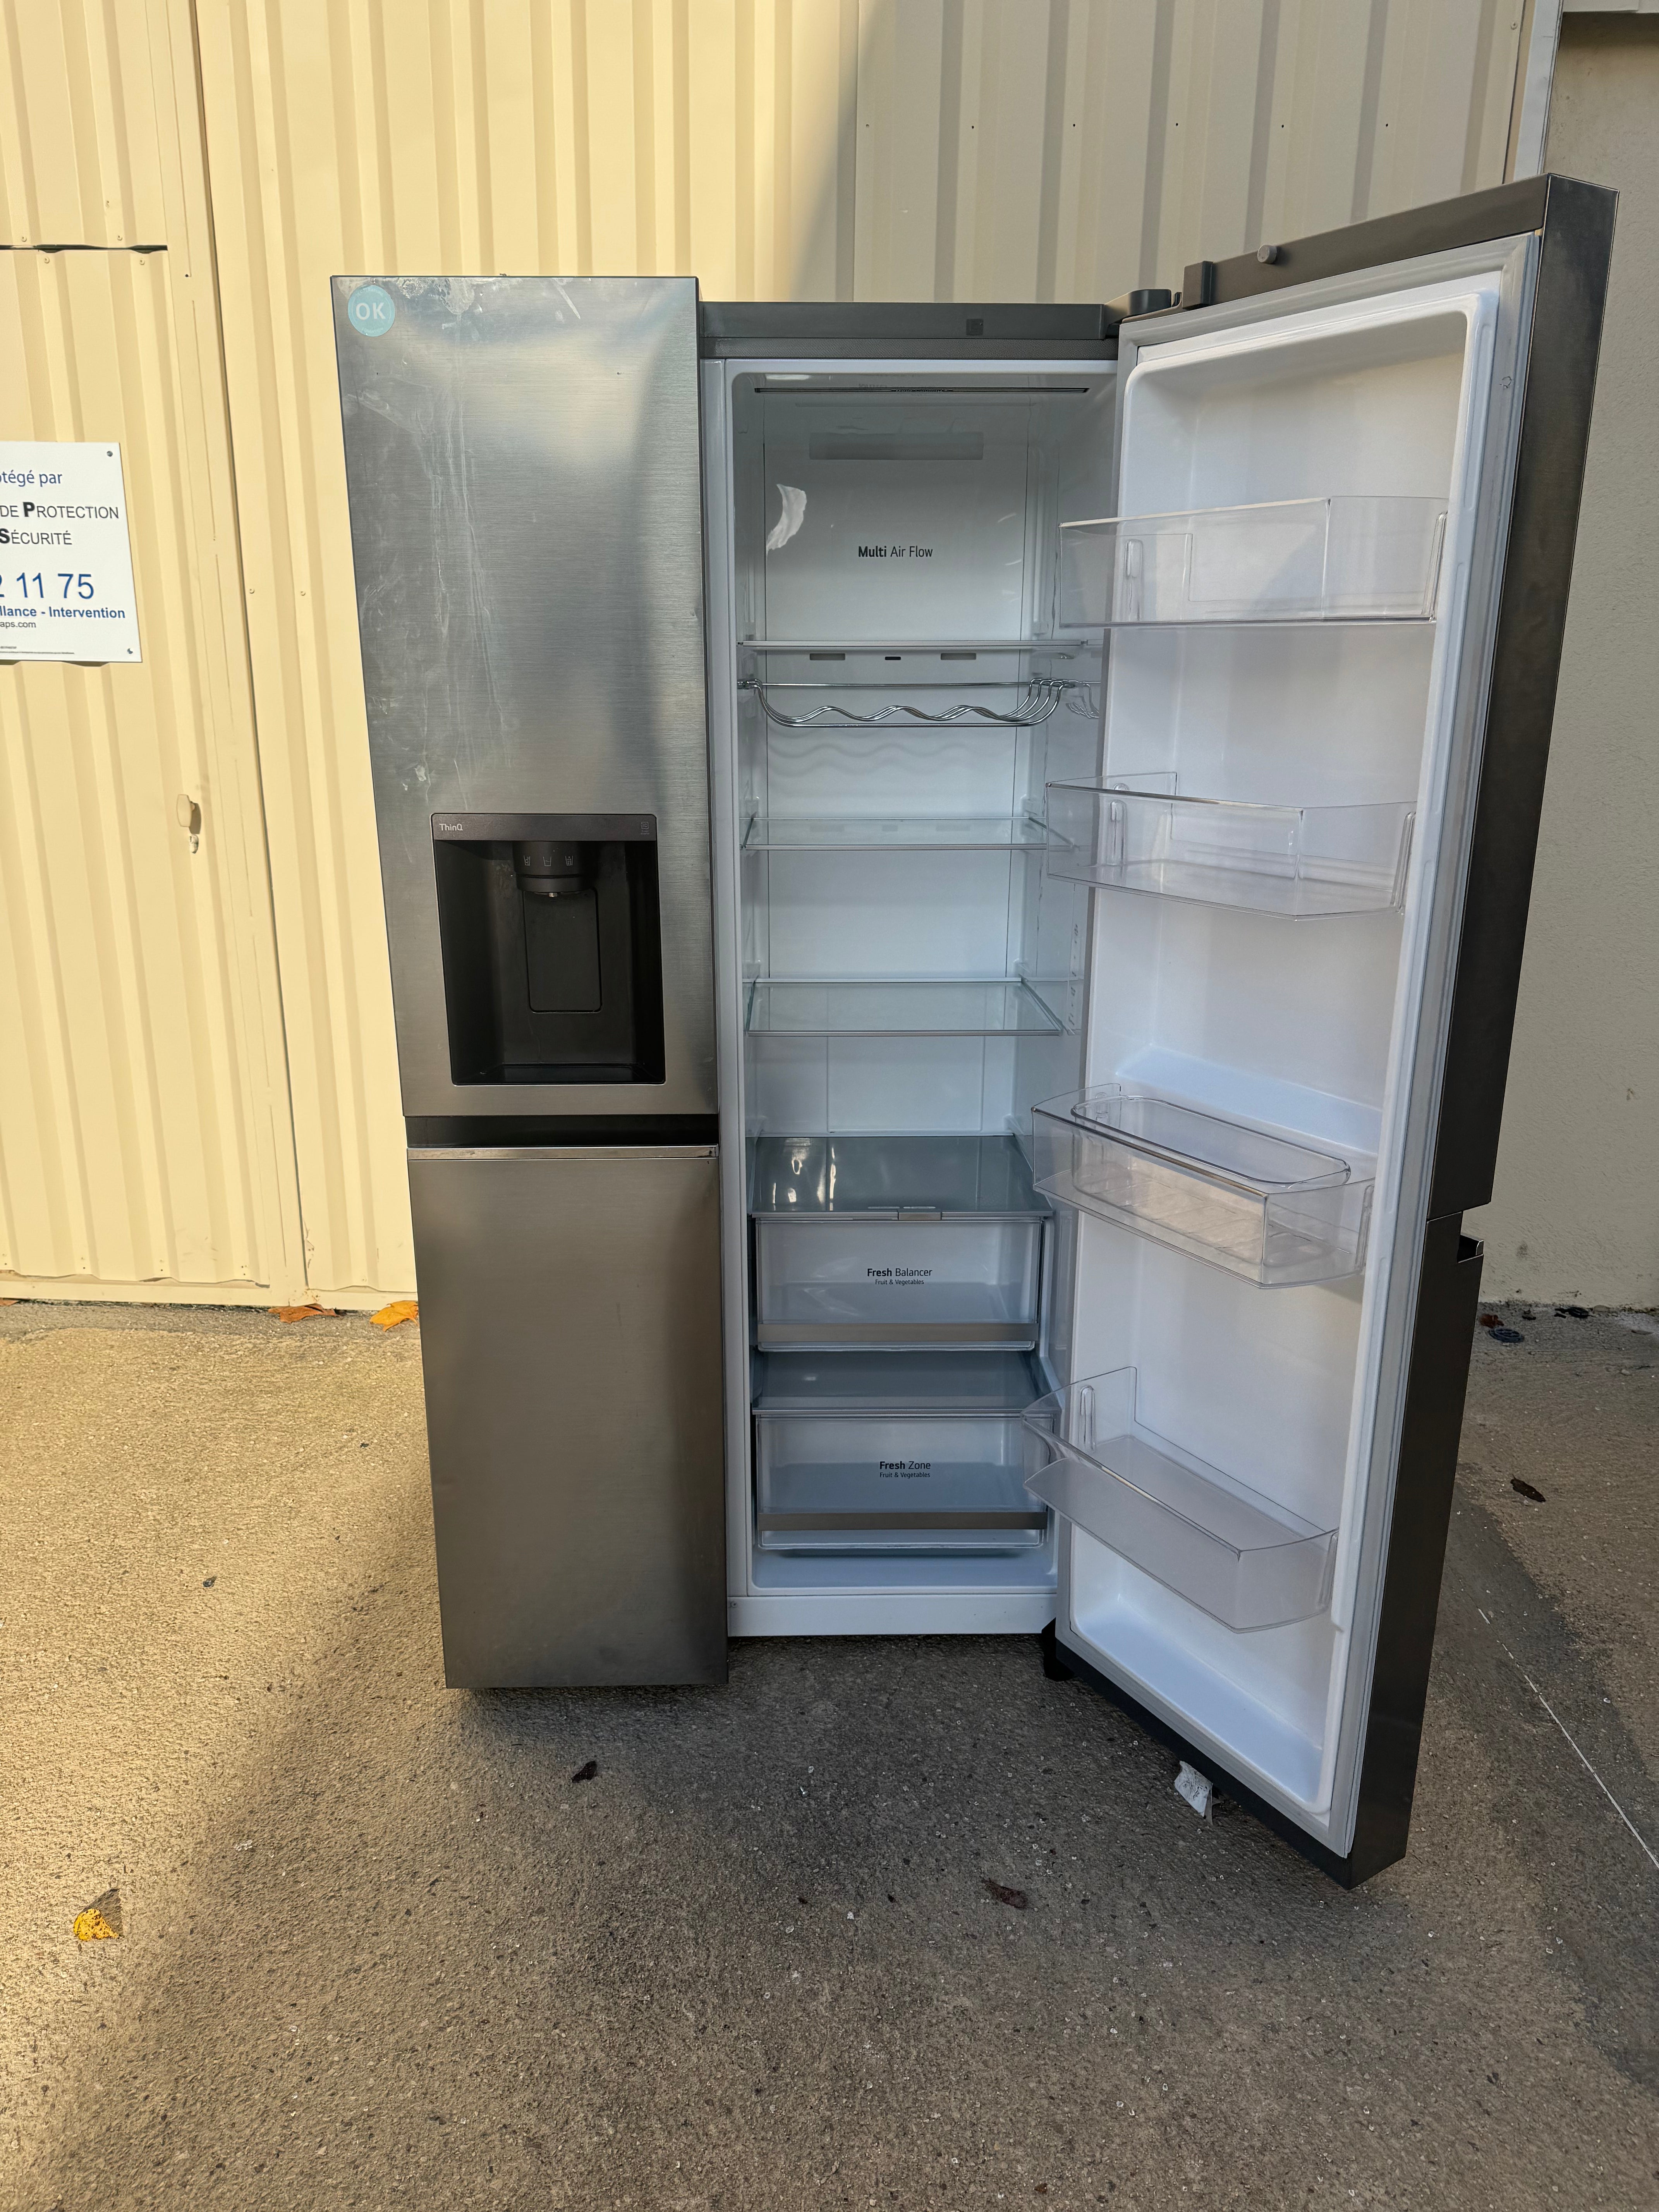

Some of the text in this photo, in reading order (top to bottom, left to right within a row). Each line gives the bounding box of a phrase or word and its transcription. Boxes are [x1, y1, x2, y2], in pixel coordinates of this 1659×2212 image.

[356, 302, 386, 320] OK
[0, 469, 62, 487] tégé par
[0, 502, 118, 519] DE PROTECTION
[859, 546, 933, 557] Multi Air Flow
[17, 572, 44, 598] 11
[58, 573, 94, 599] 75
[49, 606, 125, 618] Intervention
[439, 823, 463, 831] ThinQ
[867, 1268, 933, 1277] Fresh Balancer
[879, 1461, 931, 1470] Fresh Zone
